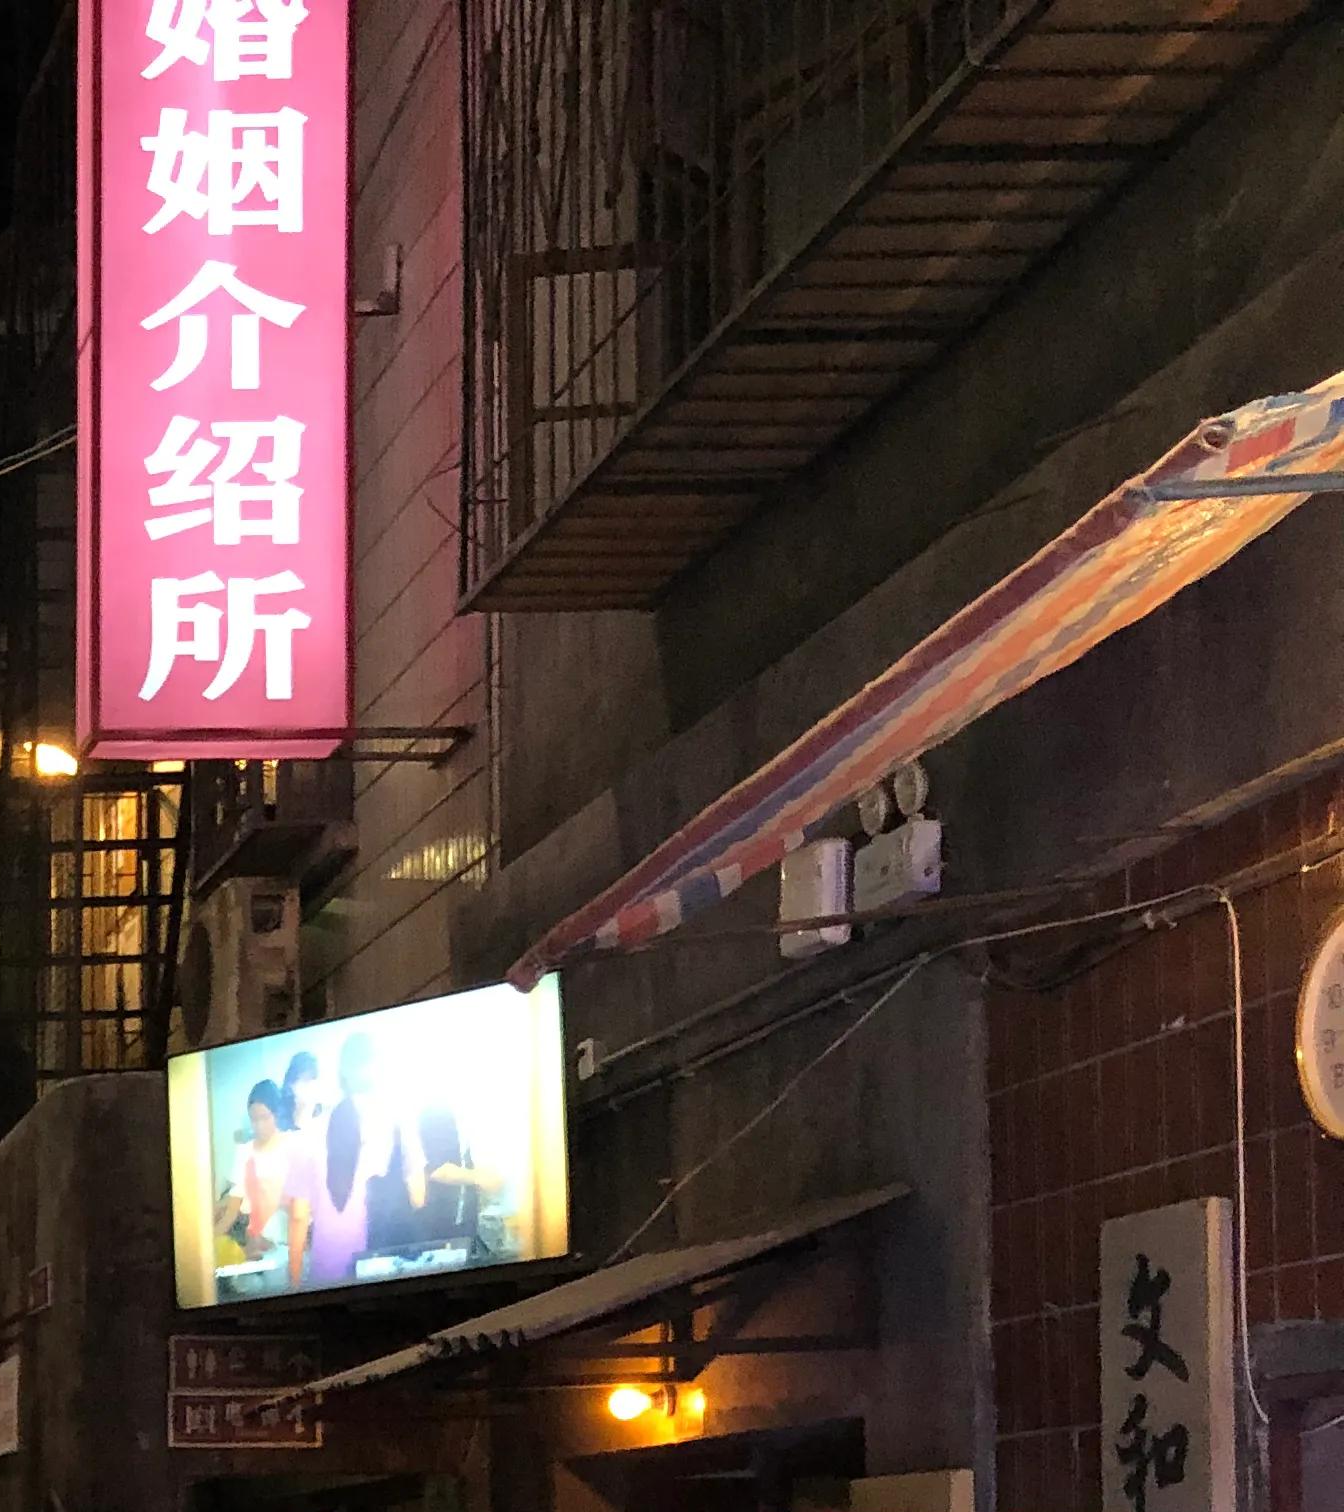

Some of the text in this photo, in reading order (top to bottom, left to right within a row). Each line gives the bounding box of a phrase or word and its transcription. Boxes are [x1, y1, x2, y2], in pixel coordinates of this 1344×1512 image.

[139, 0, 312, 701] 婚姻介绍所
